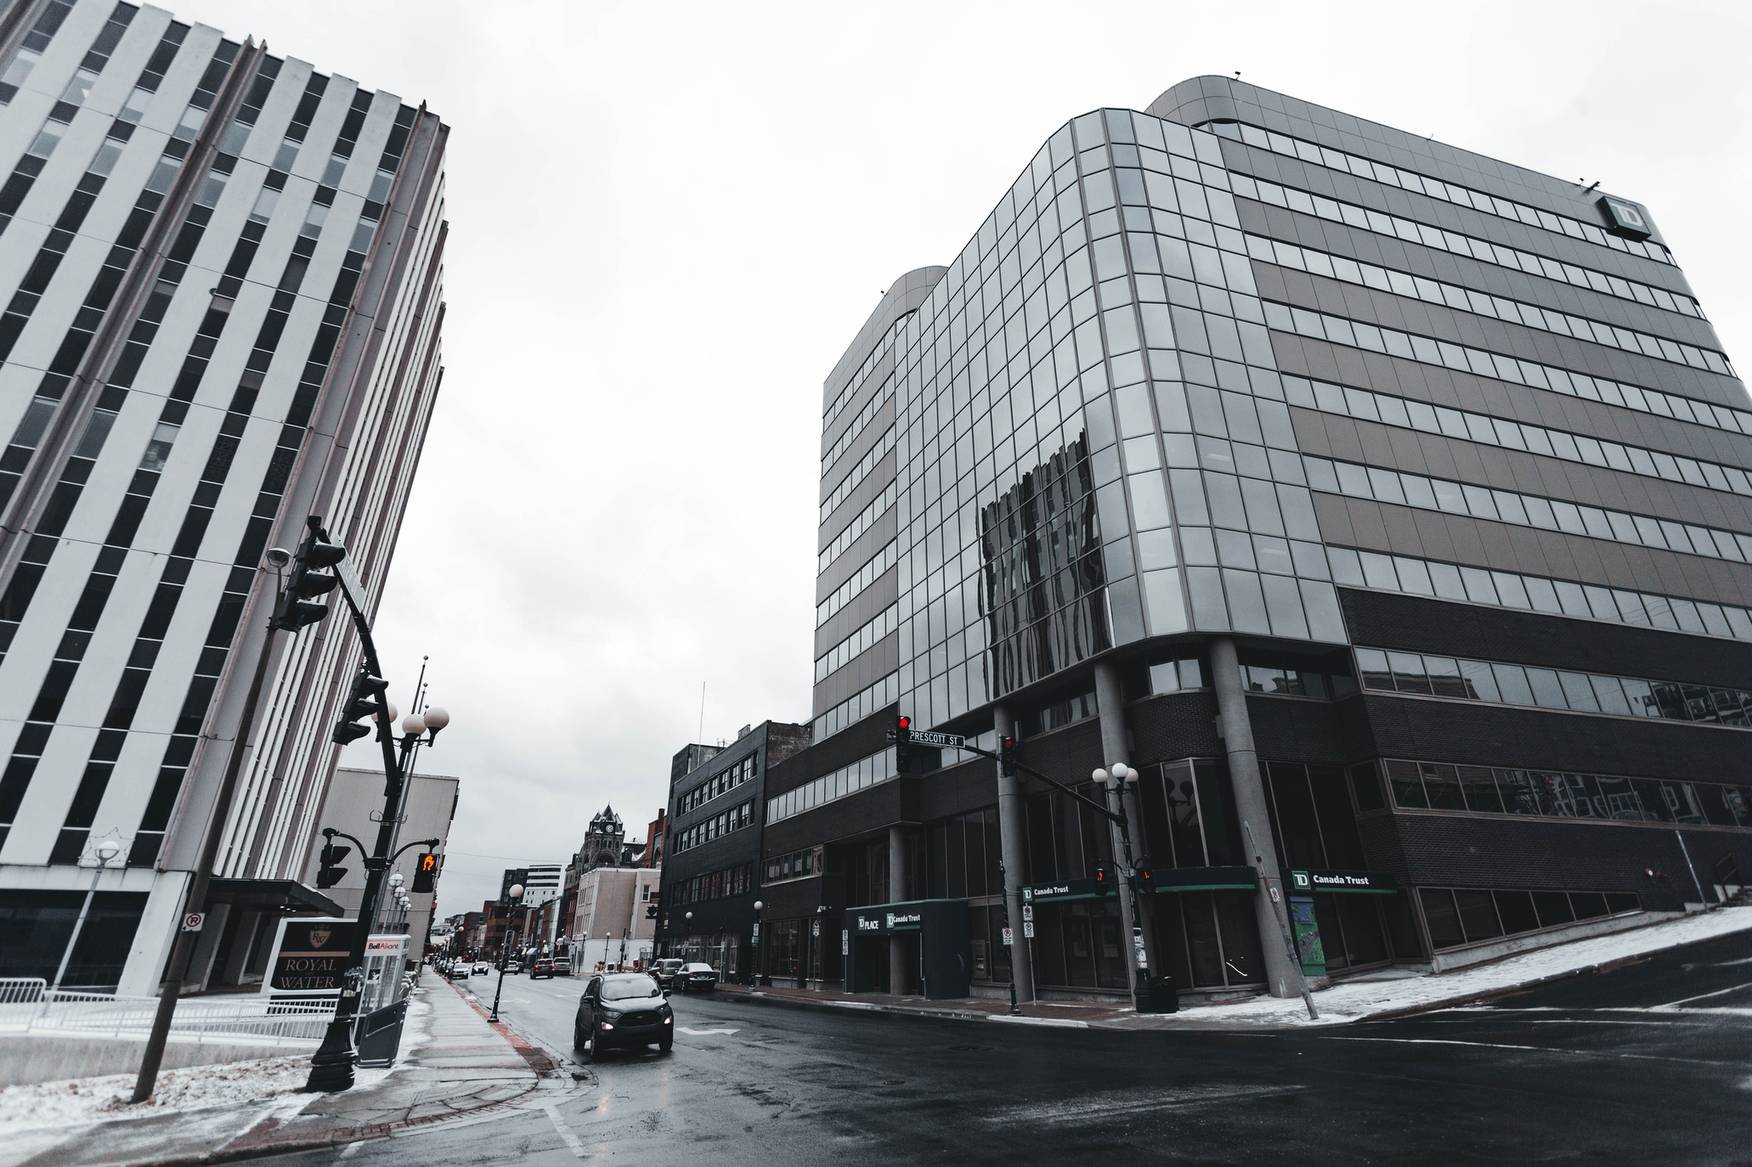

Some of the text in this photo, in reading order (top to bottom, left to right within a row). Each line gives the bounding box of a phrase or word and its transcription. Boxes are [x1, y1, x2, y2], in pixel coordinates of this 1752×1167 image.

[1611, 201, 1644, 227] TD
[910, 731, 958, 745] PRESCOTT ST
[1294, 874, 1369, 885] TD Canada Trust
[1034, 888, 1053, 896] Canada
[1053, 886, 1069, 895] Trust
[864, 920, 880, 930] PLACE
[286, 959, 337, 971] ROYAL
[281, 976, 335, 988] WATER
